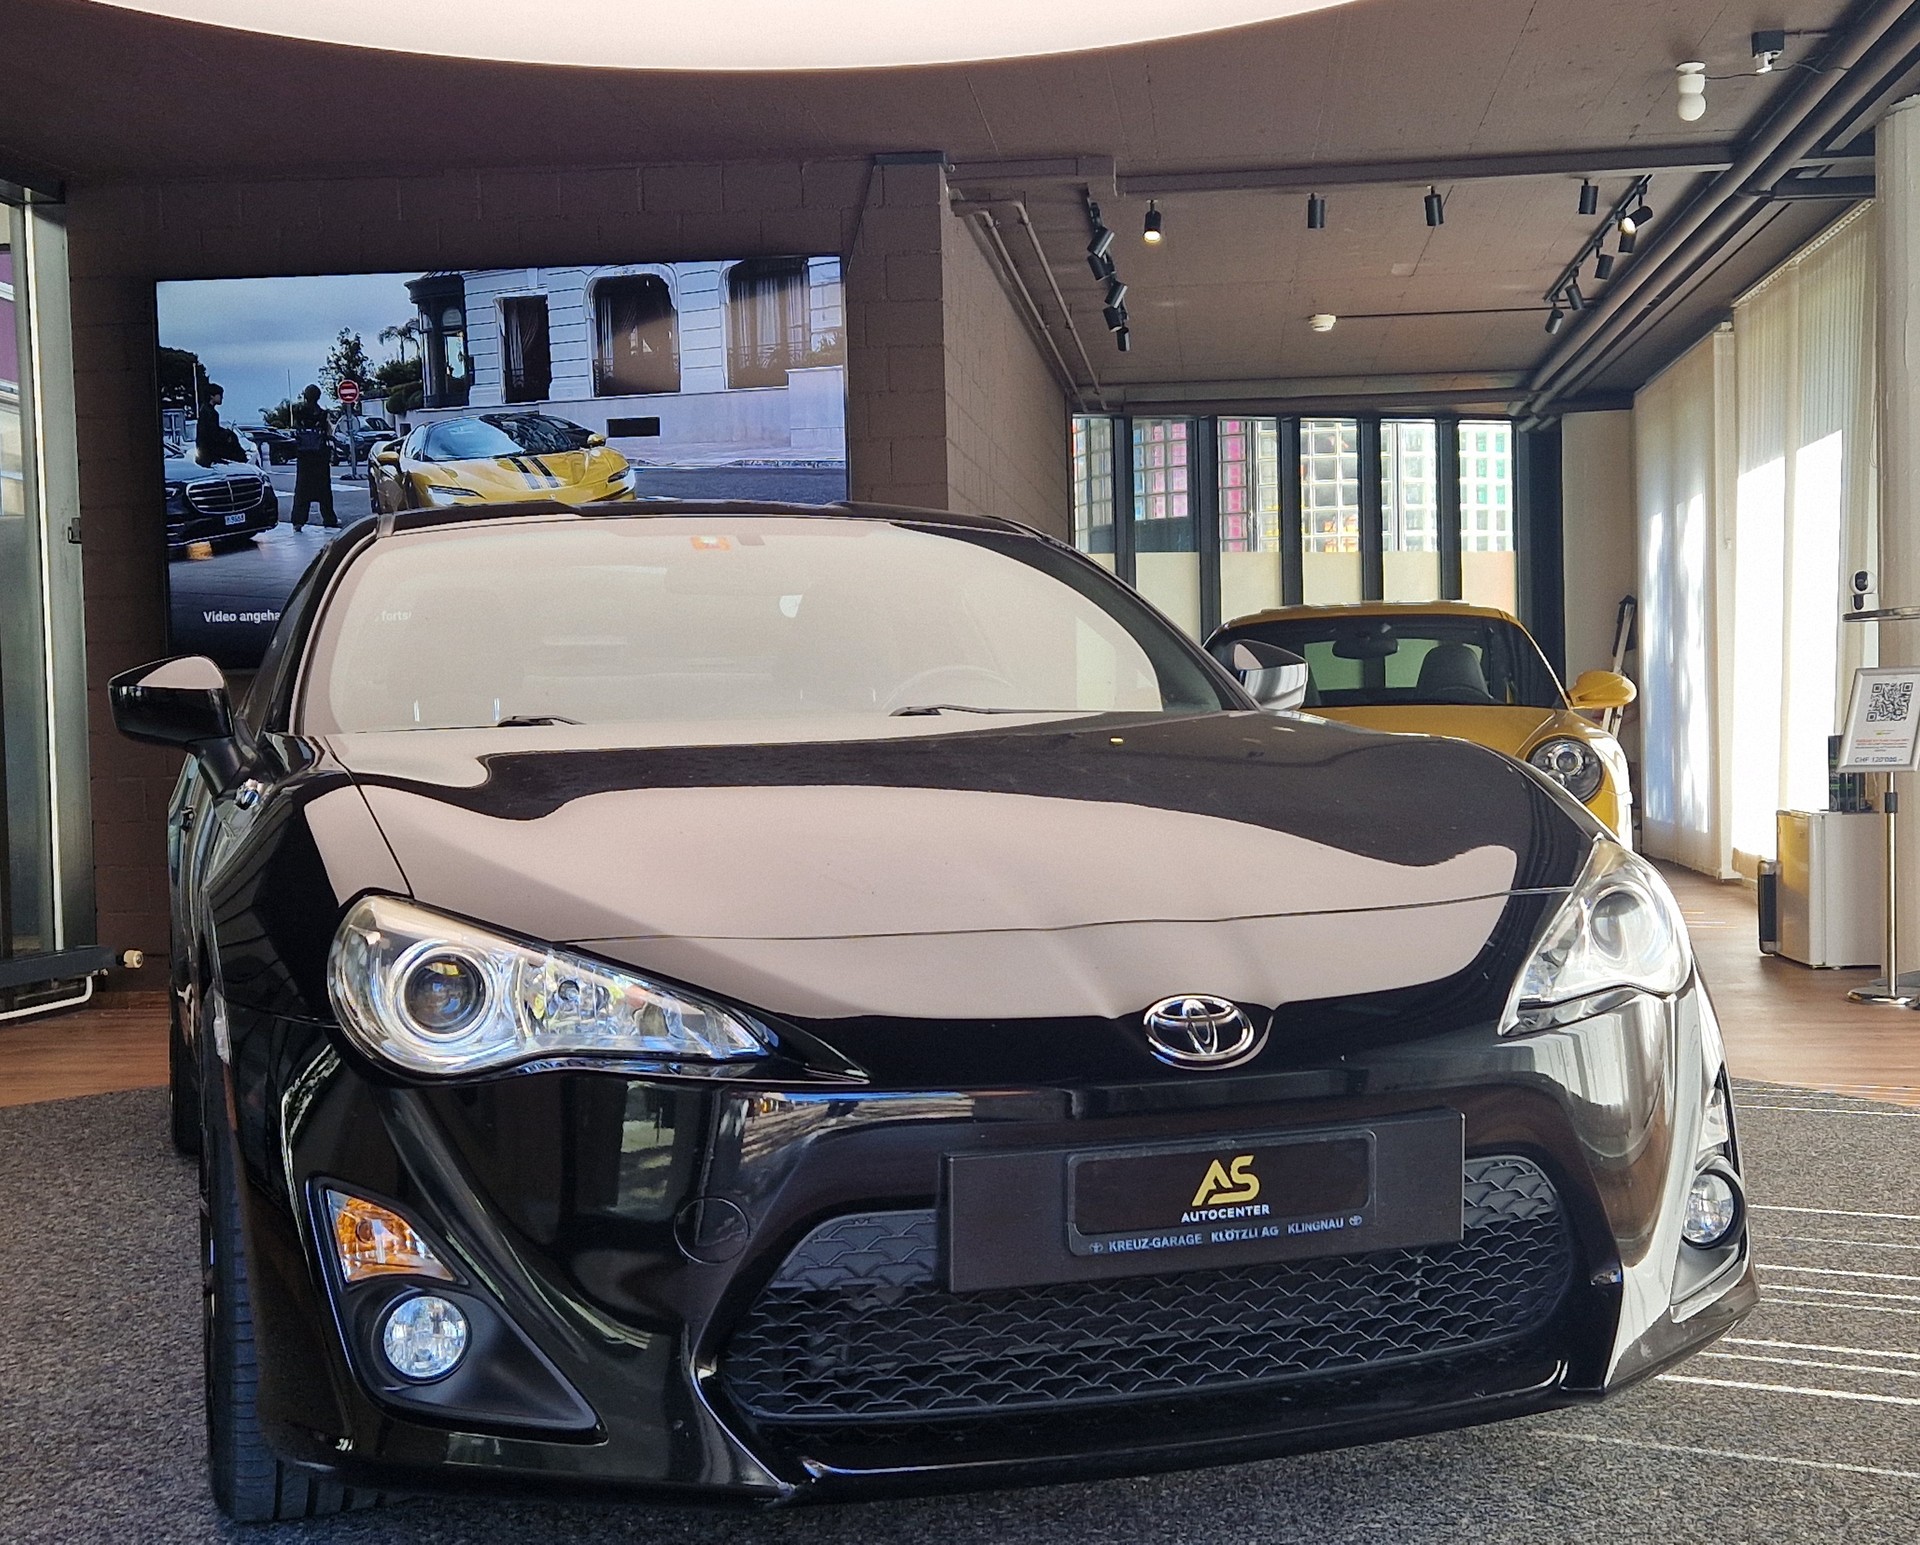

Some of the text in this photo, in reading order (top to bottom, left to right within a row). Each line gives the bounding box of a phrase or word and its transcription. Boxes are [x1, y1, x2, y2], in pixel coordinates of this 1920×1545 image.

[203, 611, 237, 623] Video
[1192, 1155, 1260, 1207] AS
[1181, 1204, 1270, 1223] AUTOCENTER
[1108, 1218, 1344, 1253] KREUZ-GARAGE KLÖTZLI AG KLINGNAU
